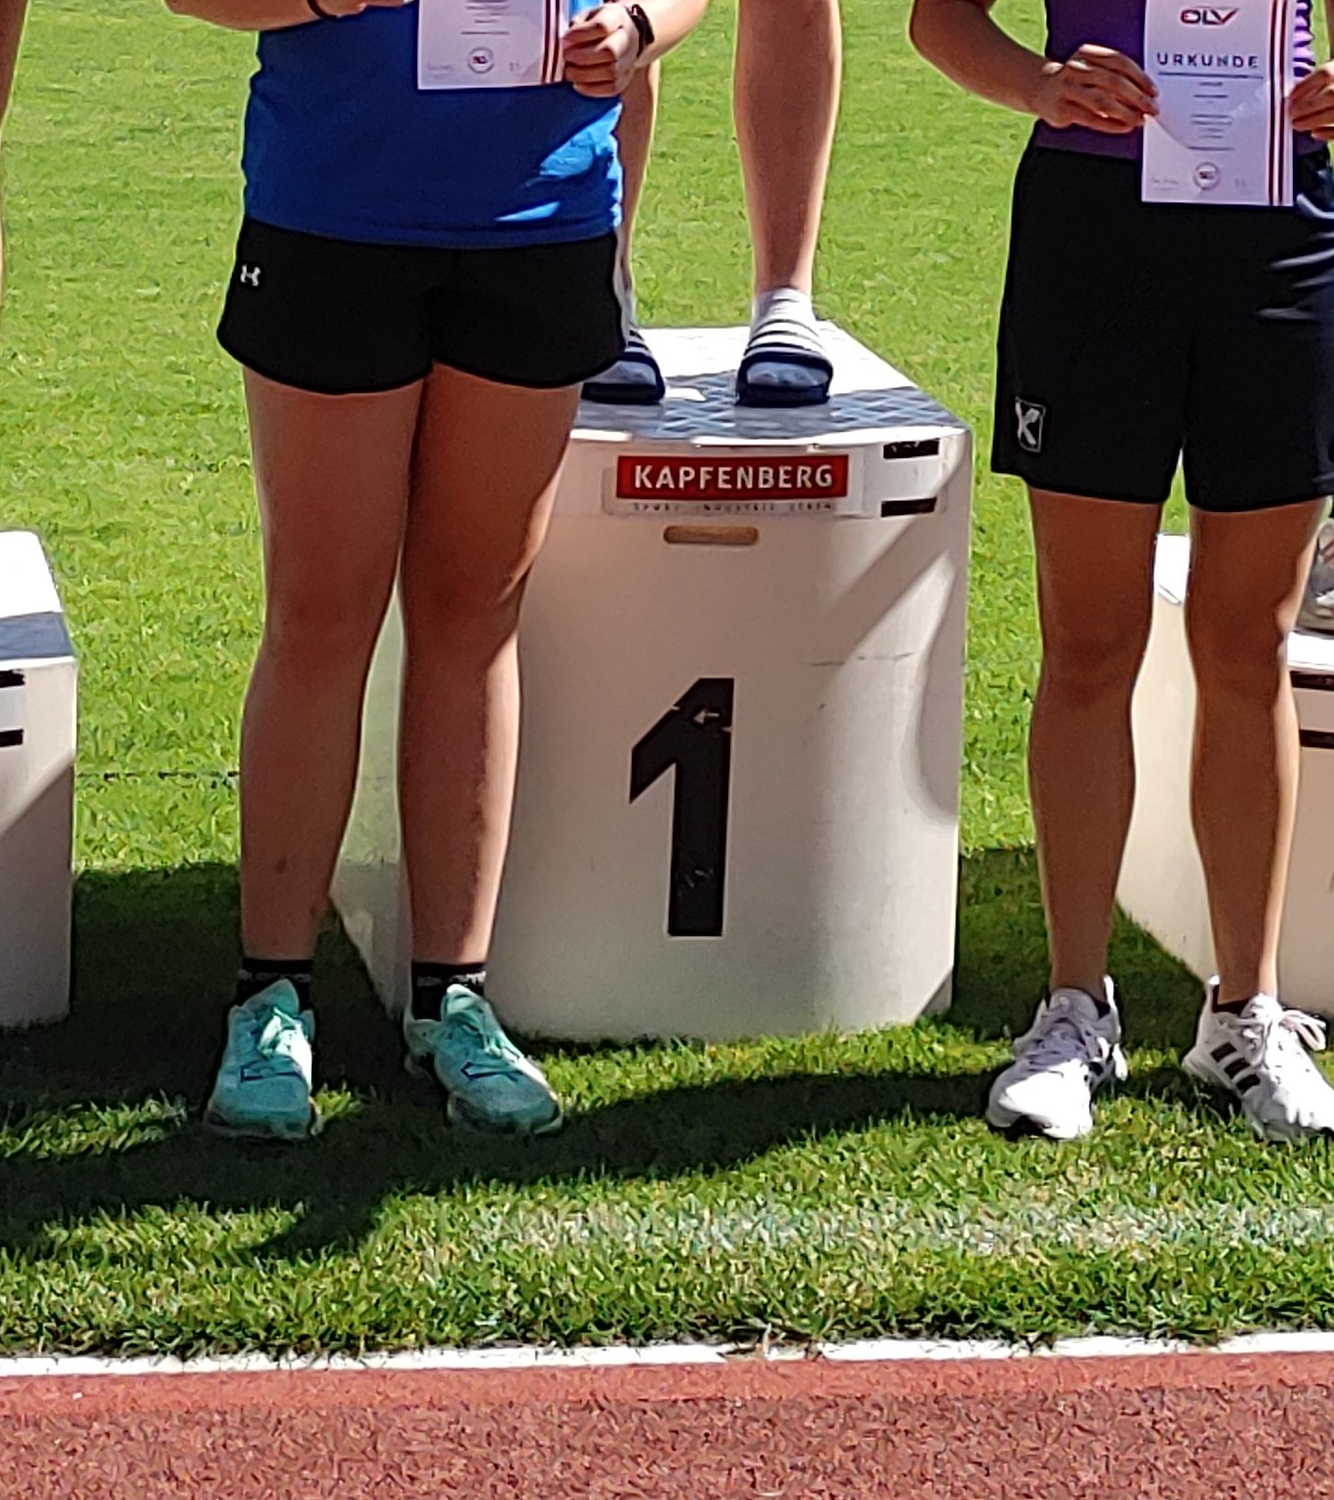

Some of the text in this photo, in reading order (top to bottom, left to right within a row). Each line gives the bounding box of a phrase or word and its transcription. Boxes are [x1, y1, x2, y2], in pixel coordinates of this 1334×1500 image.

[1156, 52, 1260, 69] URKUNDE
[634, 464, 834, 491] KAPFENBERG
[629, 677, 735, 937] 1
